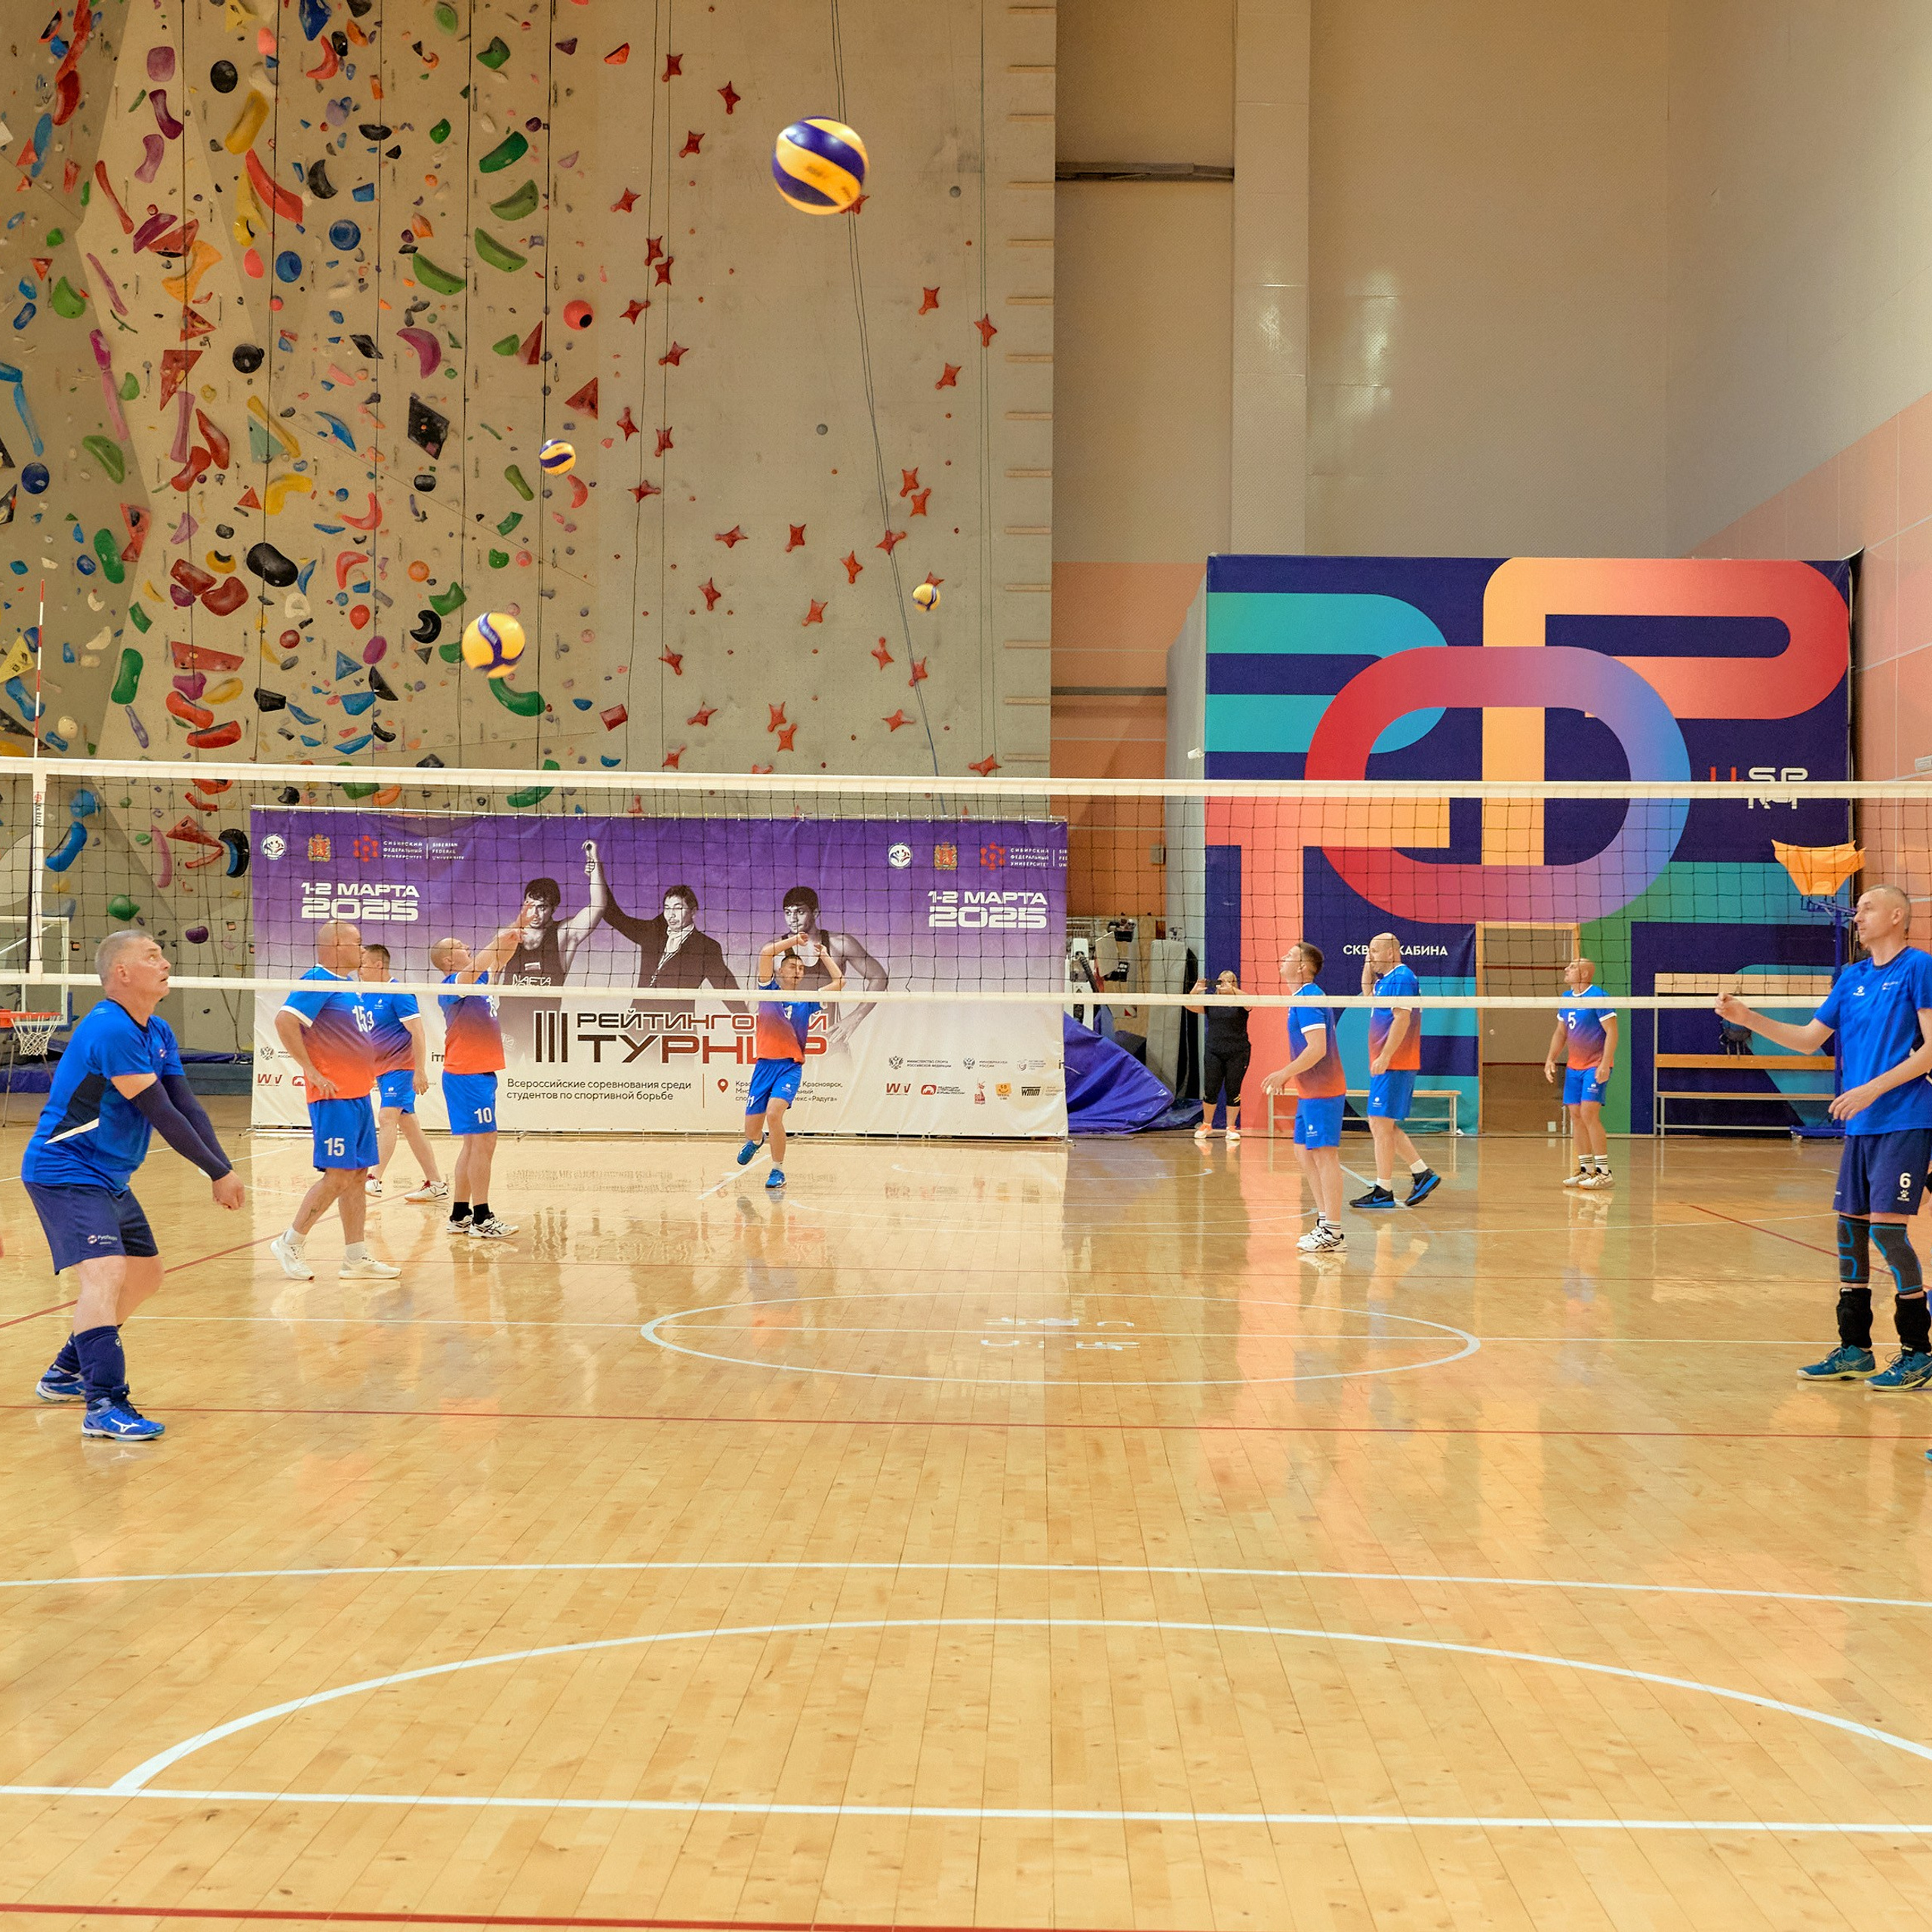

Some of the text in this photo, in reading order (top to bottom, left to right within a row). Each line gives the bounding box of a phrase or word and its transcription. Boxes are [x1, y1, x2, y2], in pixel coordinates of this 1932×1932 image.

[301, 882, 420, 898] 1-2 МАРТА
[928, 891, 1048, 906] 1-2 МАРТА
[301, 897, 419, 921] 2025
[928, 906, 1048, 929] 2025
[352, 1004, 368, 1033] 15
[577, 1008, 827, 1031] РЕЙТИНГОЙ
[1567, 1011, 1577, 1029] 5
[535, 1012, 568, 1063] III
[507, 1078, 691, 1091] Всероссийские соревнования среди
[506, 1091, 558, 1100] студентов
[574, 1091, 635, 1102] спортивной
[636, 1091, 674, 1102] борьбе
[474, 1107, 493, 1124] 10
[324, 1137, 346, 1156] 15
[1899, 1172, 1912, 1189] 6
